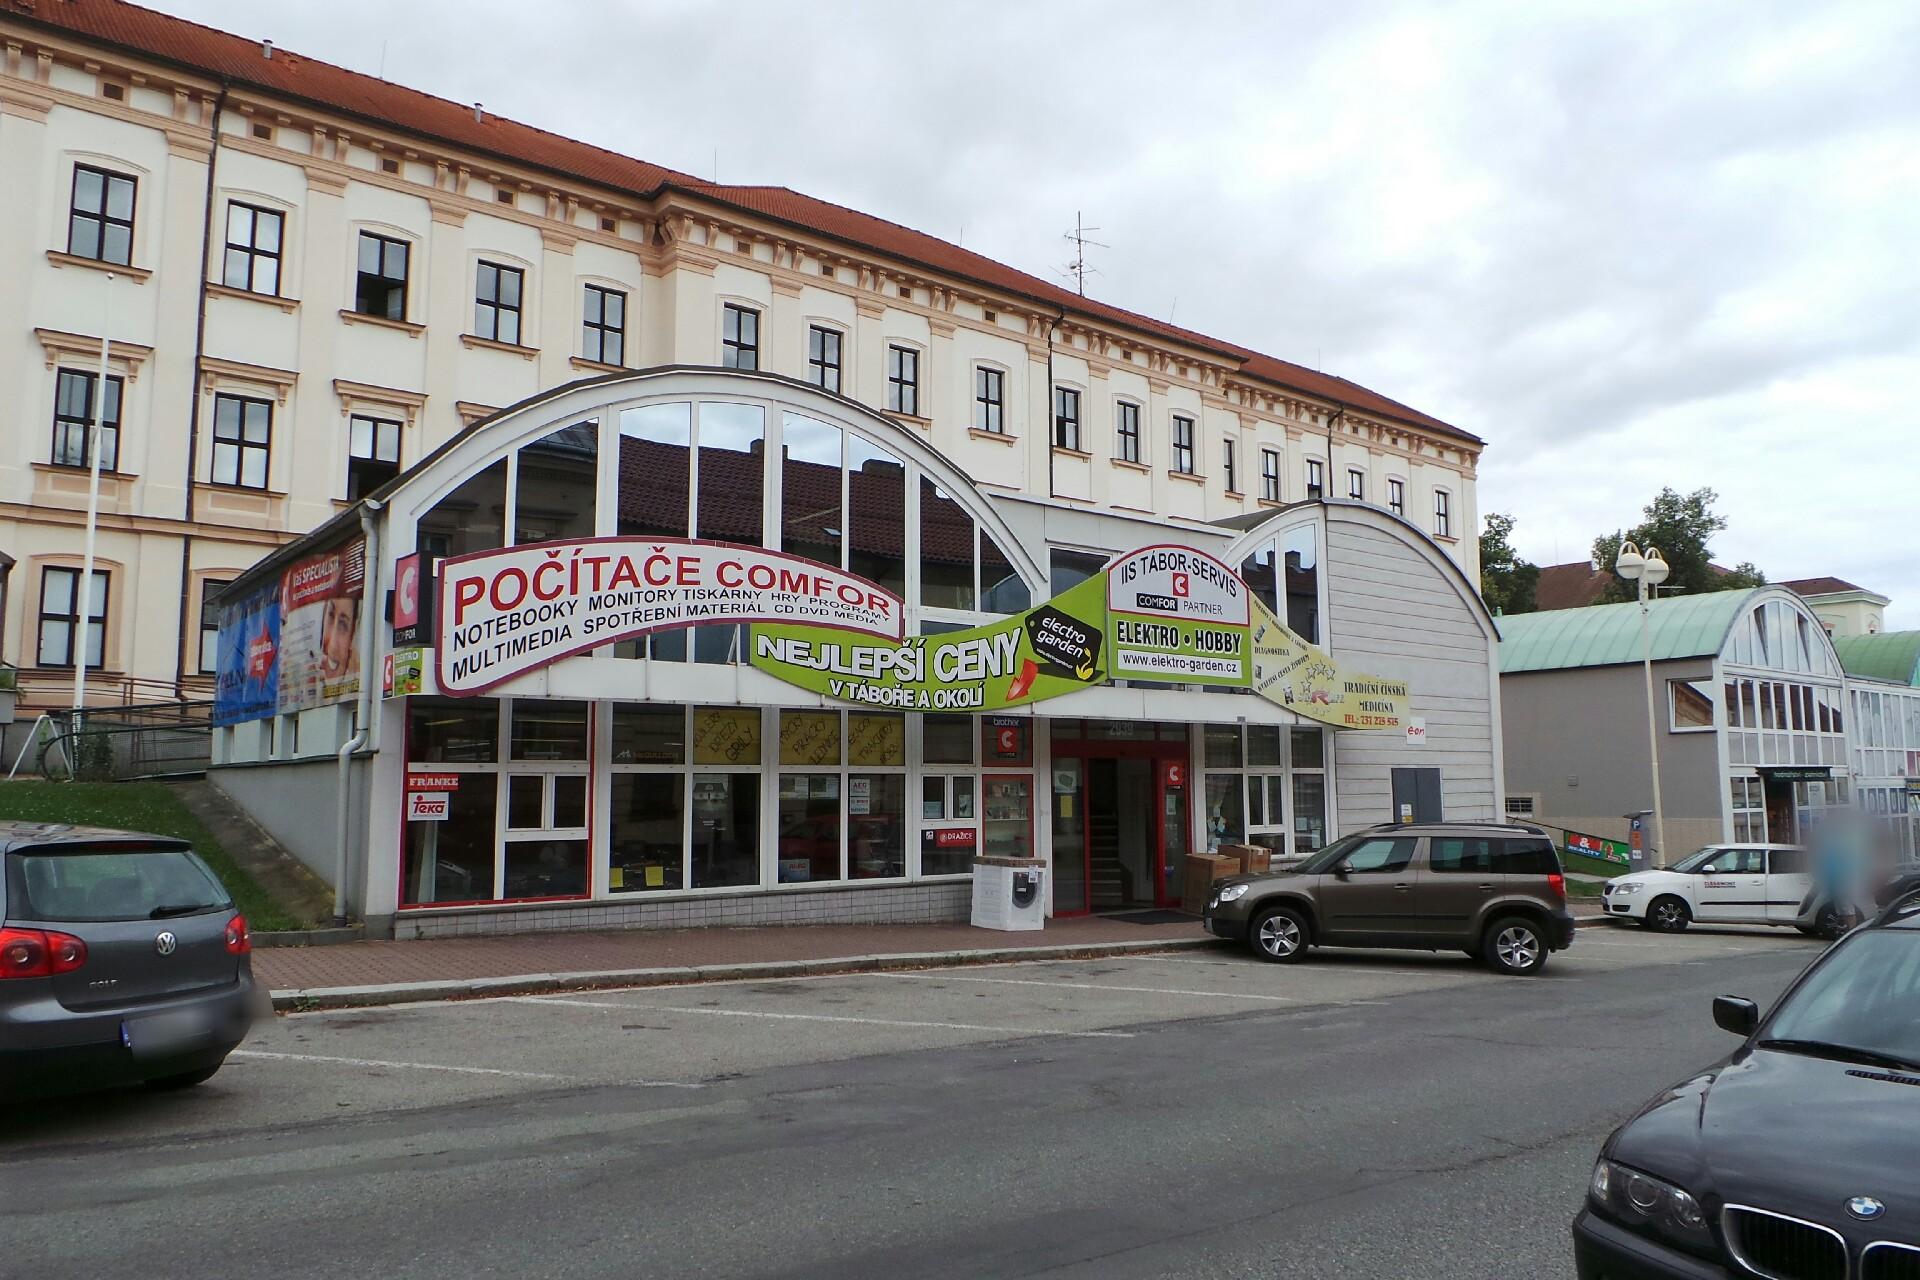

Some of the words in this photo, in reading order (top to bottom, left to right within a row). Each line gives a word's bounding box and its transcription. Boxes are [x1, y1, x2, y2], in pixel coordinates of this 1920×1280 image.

[453, 546, 701, 626] POČÍTAČE
[716, 560, 891, 617] COMFOR
[1121, 565, 1137, 585] IIS
[1140, 551, 1237, 598] TÁBOR-SERVIS
[1138, 595, 1176, 610] COMFOR
[1183, 600, 1223, 615] PARTNER
[453, 599, 579, 652] NOTEBOOKY
[589, 588, 678, 614] MONITORY
[682, 587, 763, 602] TISKÁRNY
[770, 592, 800, 604] HRY
[808, 596, 891, 622] PROGRAMY
[1042, 617, 1086, 644] electro
[452, 623, 572, 683] MULTIMEDIA
[583, 604, 681, 635] SPOTŘEBNÍ
[686, 601, 766, 617] MATERIÁL
[774, 604, 795, 615] CD
[799, 606, 830, 618] DVD
[834, 610, 878, 626] MEDIA
[1036, 630, 1083, 658] garden
[1117, 620, 1180, 648] ELEKTRO
[1195, 628, 1242, 654] HOBBY
[757, 633, 925, 683] NEJLEPŠÍ
[933, 626, 1022, 683] CENY
[1123, 652, 1238, 673] www.elektro-garden.cz
[829, 679, 843, 696] V
[846, 679, 915, 708] TÁBOŘE
[917, 692, 931, 708] A
[933, 681, 985, 708] OKOLÍ
[993, 717, 1020, 726] brother
[409, 777, 459, 786] FRANKE
[947, 831, 973, 840] DRAŽICE
[1633, 820, 1640, 829] P
